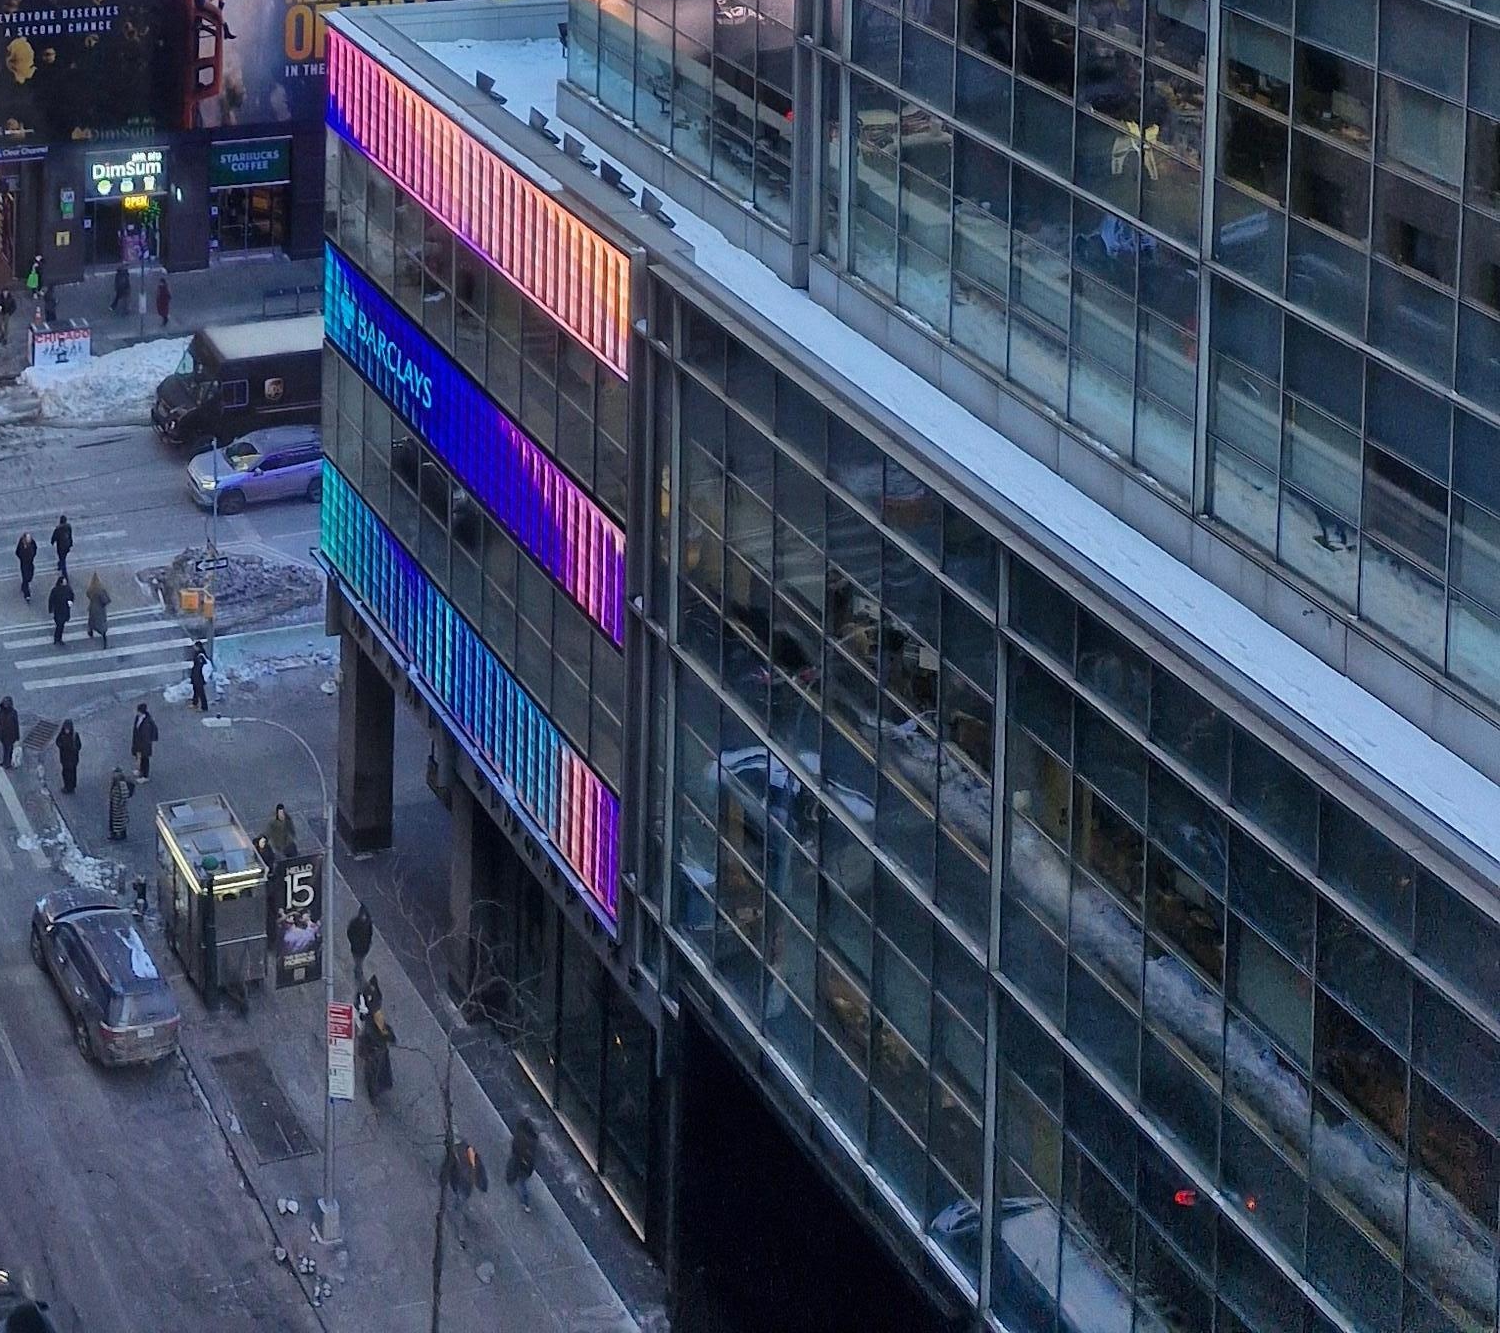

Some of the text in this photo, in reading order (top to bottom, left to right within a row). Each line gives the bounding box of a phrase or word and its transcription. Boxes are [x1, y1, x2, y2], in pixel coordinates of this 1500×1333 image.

[62, 5, 119, 19] DESERVES
[4, 20, 112, 37] A SECOND CHANCE
[285, 62, 328, 77] IN THE
[220, 149, 279, 163] STARBUCKS
[92, 161, 162, 180] DimSum
[231, 160, 269, 172] COFFEE
[124, 195, 150, 210] OPEN
[358, 308, 432, 408] BARCLAYS
[286, 863, 313, 875] HELLO
[284, 871, 315, 909] 15
